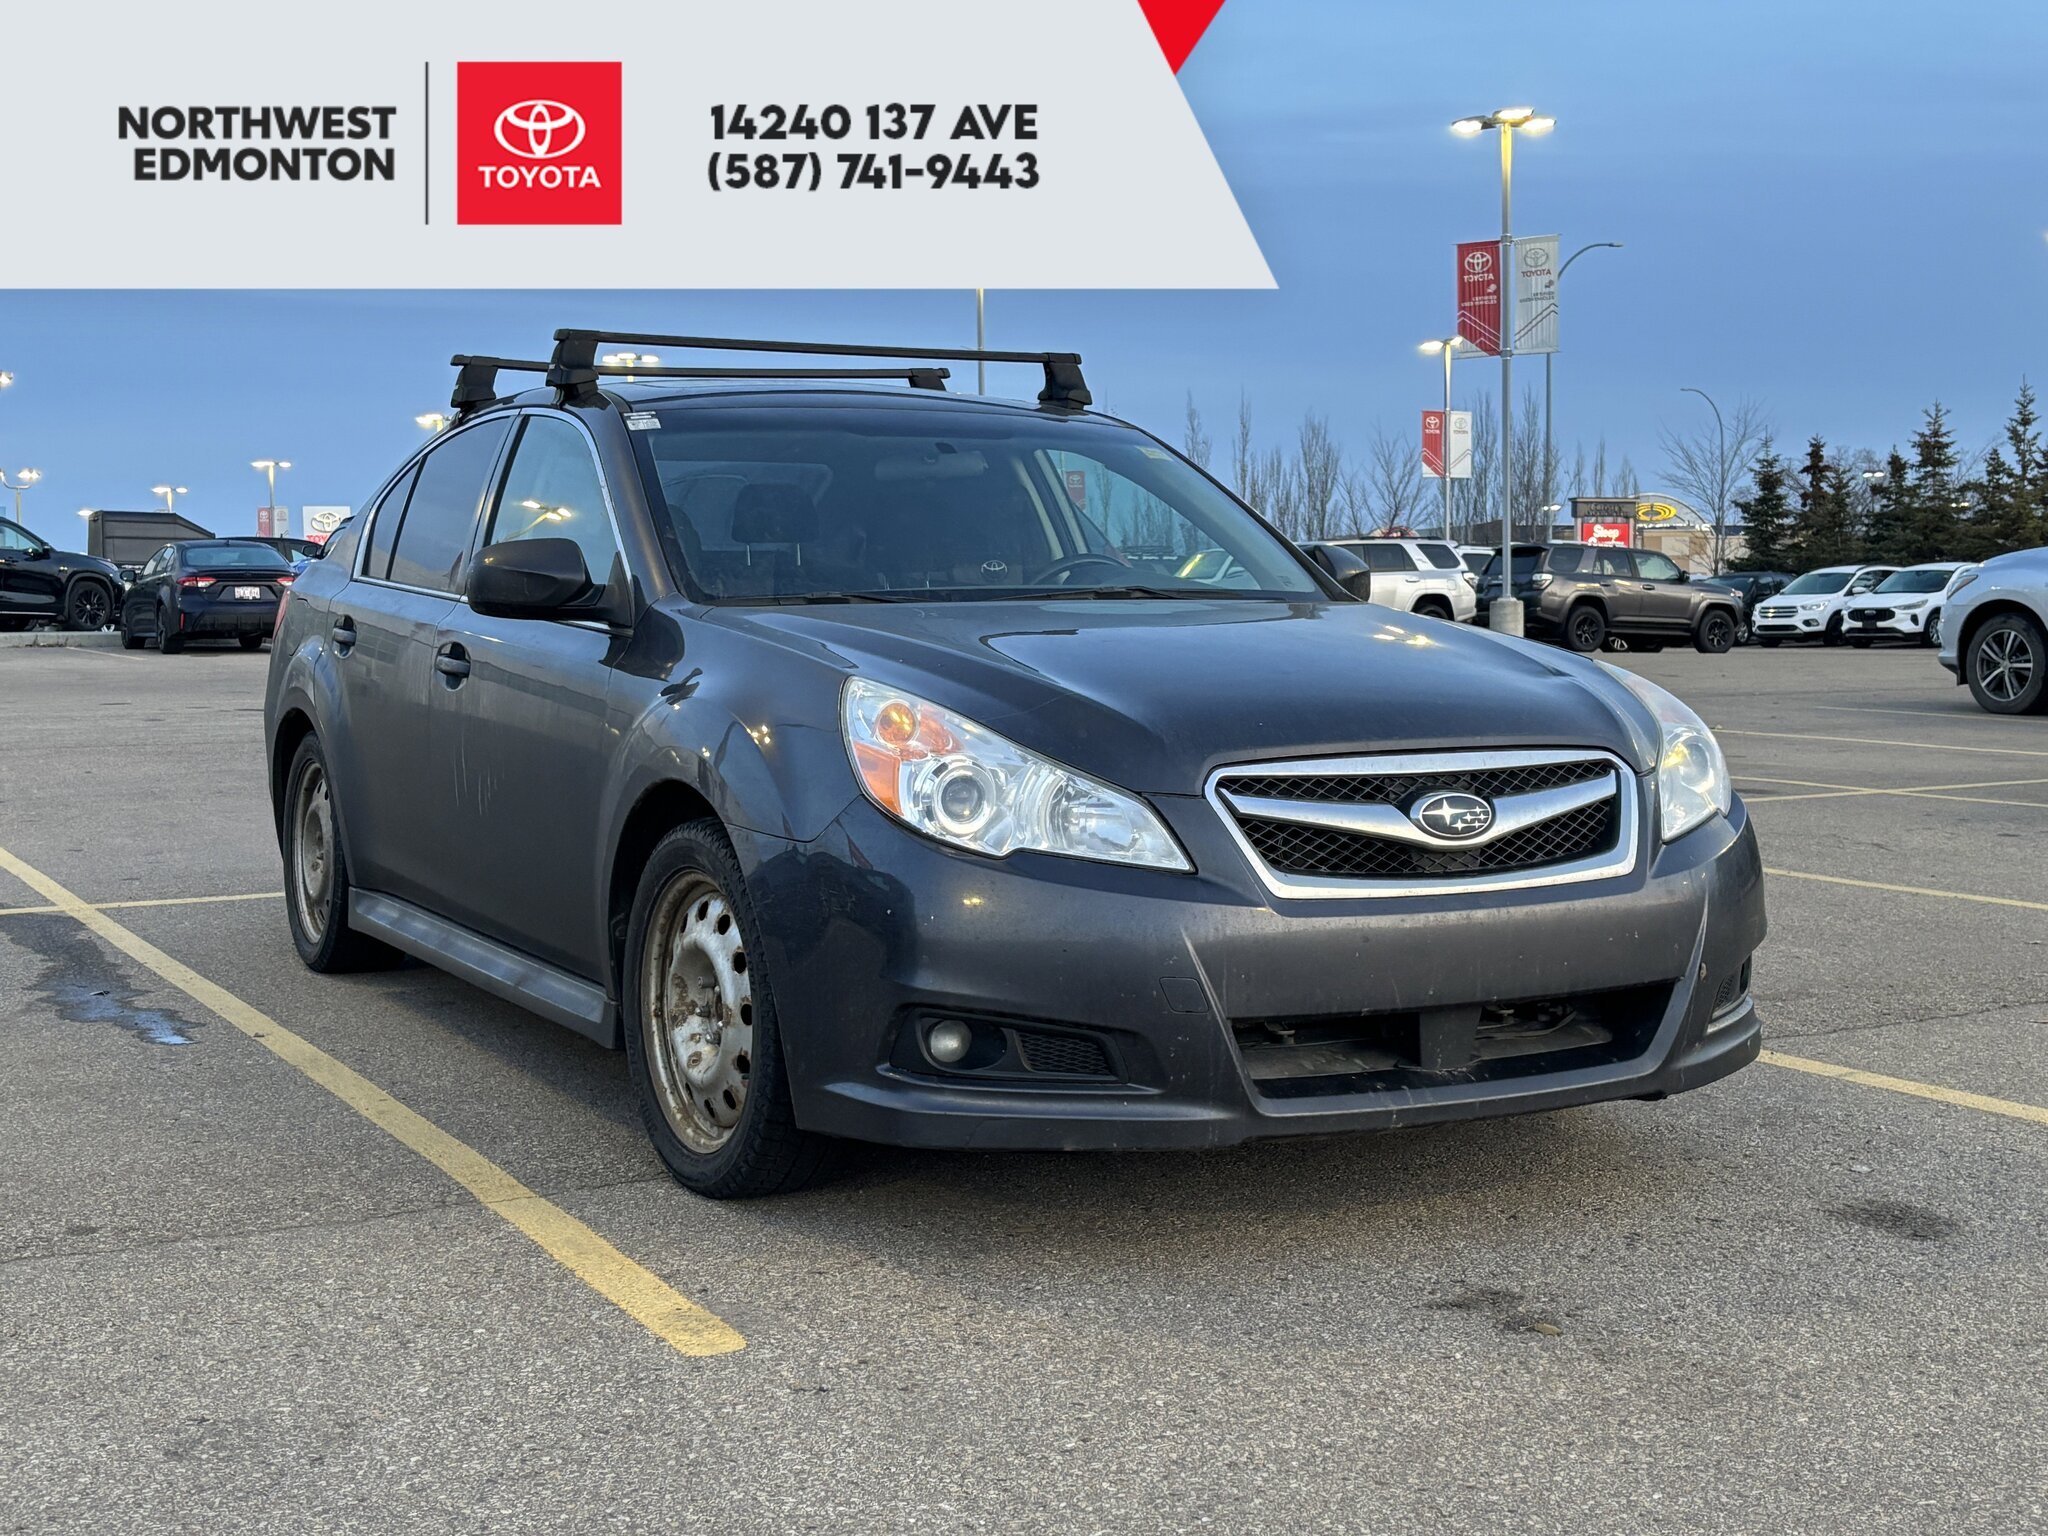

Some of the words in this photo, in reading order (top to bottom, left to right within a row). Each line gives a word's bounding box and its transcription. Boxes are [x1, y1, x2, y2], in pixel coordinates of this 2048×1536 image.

[1463, 273, 1494, 282] TOYOTA
[1521, 268, 1551, 278] TOYOTA
[1593, 524, 1620, 541] Sleep
